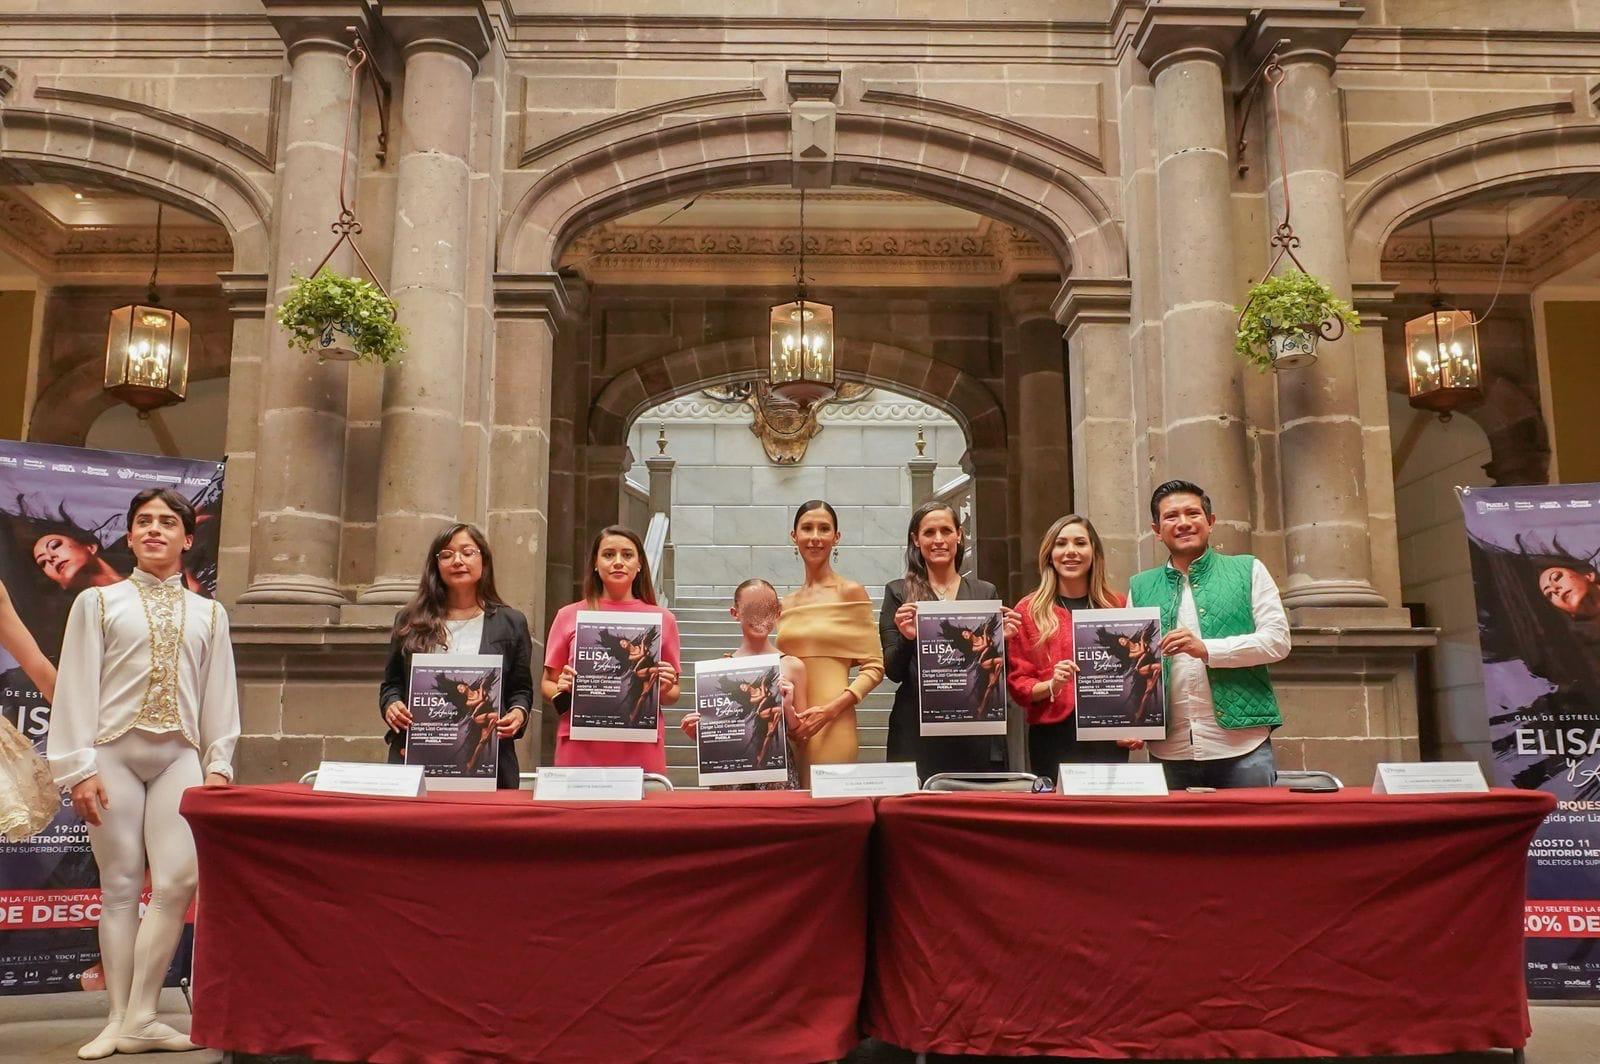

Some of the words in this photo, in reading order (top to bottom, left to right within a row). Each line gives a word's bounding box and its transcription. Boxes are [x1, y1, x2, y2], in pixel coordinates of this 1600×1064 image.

[922, 643, 953, 654] ELISA
[578, 650, 609, 660] ELISA
[1078, 651, 1109, 661] ELISA
[413, 697, 446, 707] ELISA
[700, 697, 731, 708] ELISA
[1569, 815, 1586, 824] por
[54, 825, 87, 833] 19:00
[1578, 840, 1590, 848] 11
[1527, 849, 1583, 857] AUDITORIO
[1568, 915, 1600, 932] DE
